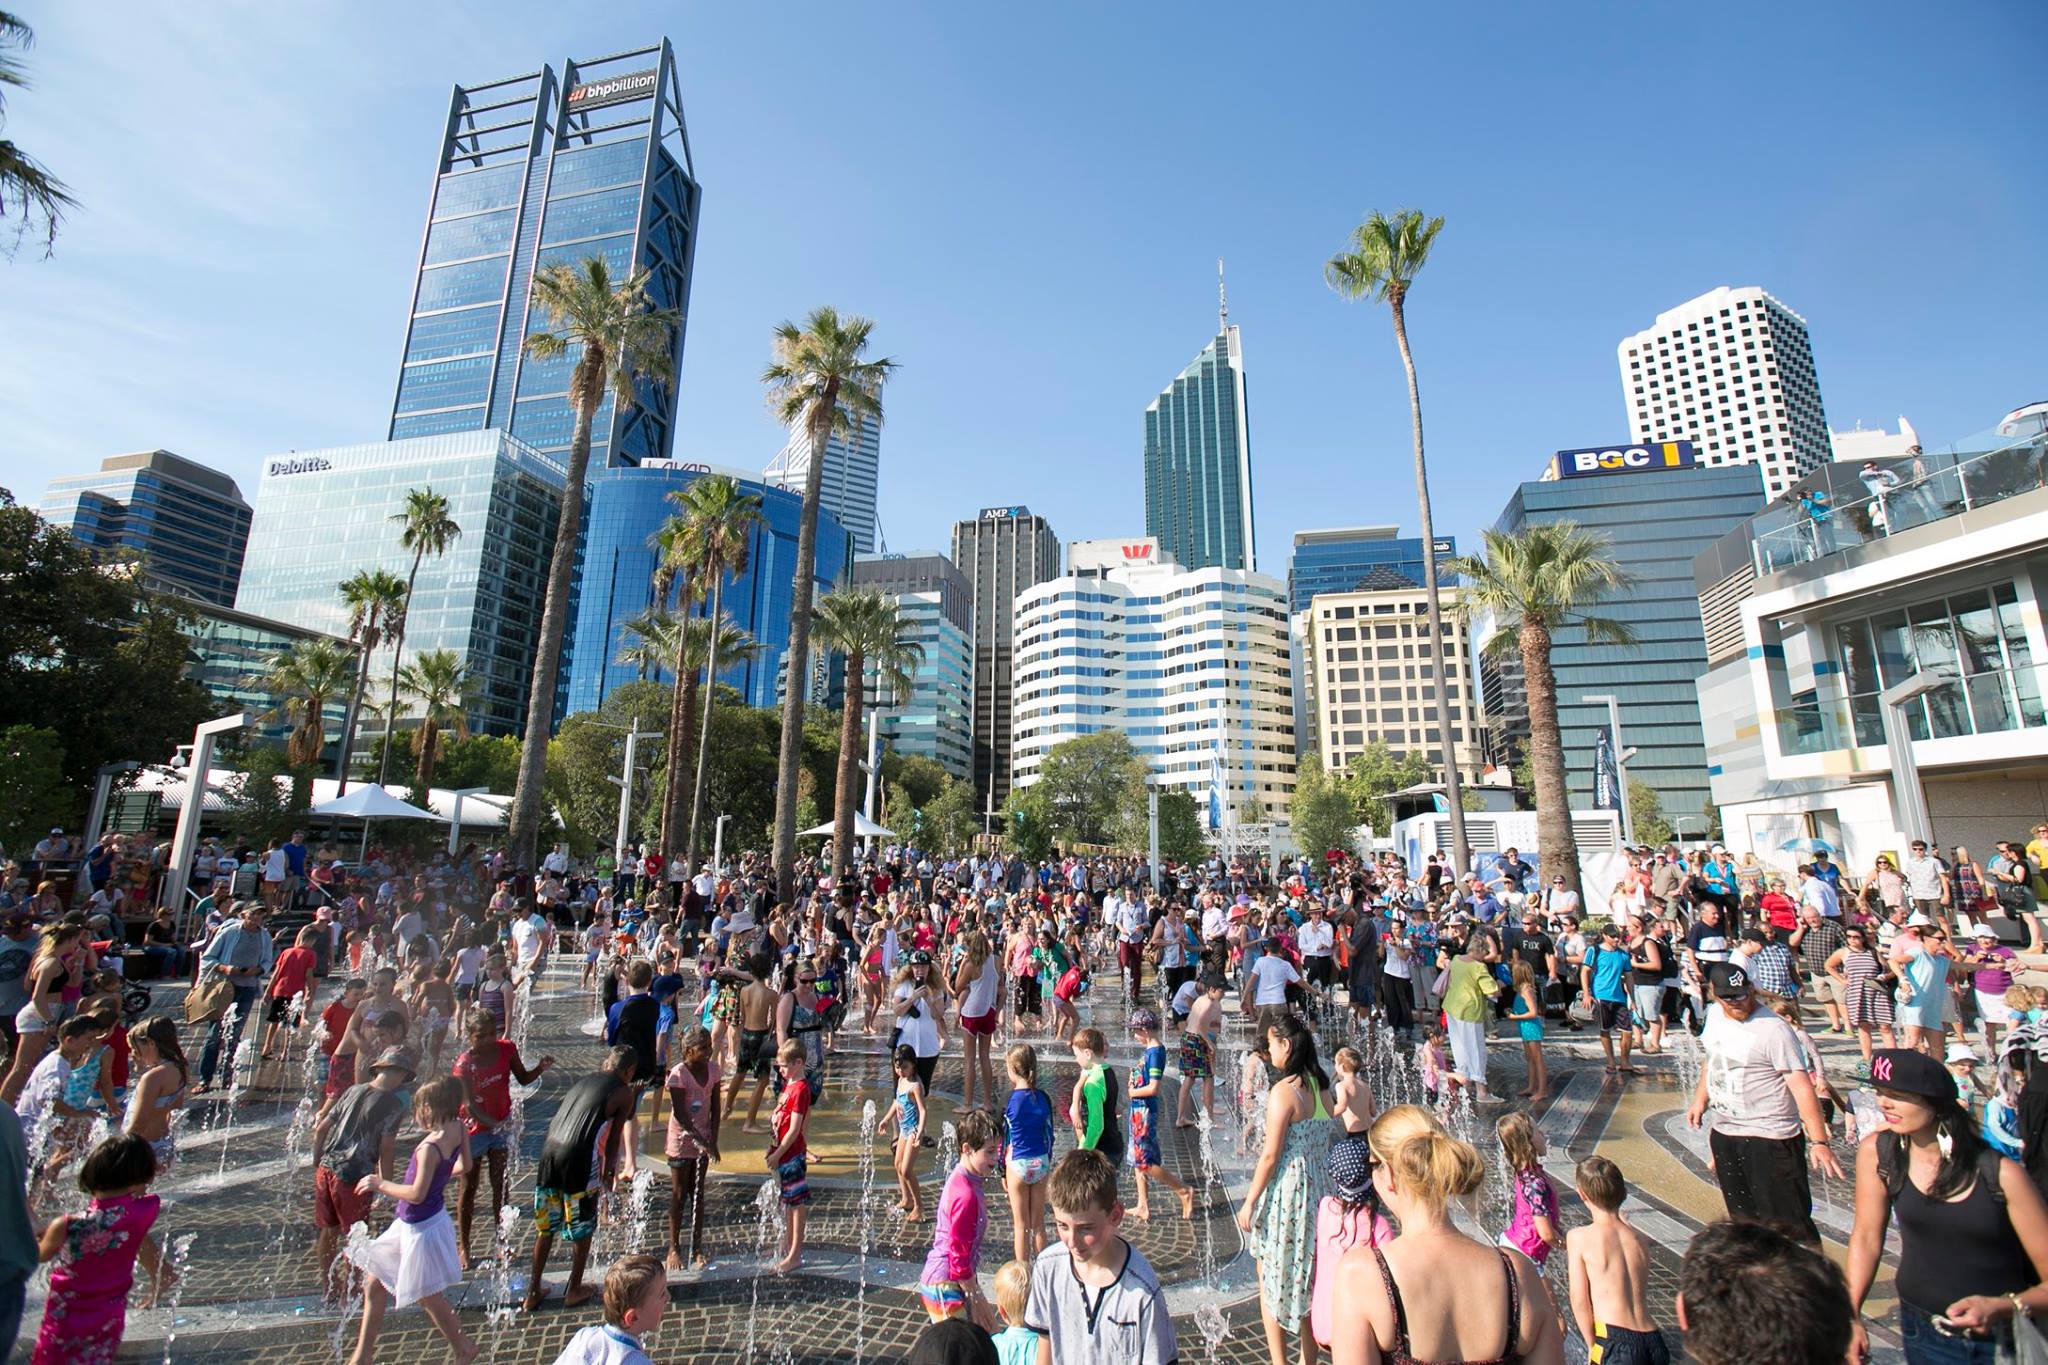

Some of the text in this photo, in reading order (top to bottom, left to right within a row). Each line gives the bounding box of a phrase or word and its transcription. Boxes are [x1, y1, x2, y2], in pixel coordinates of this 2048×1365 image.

[587, 75, 655, 98] bhpbilliton
[1574, 448, 1650, 472] BGC
[985, 508, 1008, 519] AMP
[1873, 1056, 1893, 1081] NY
